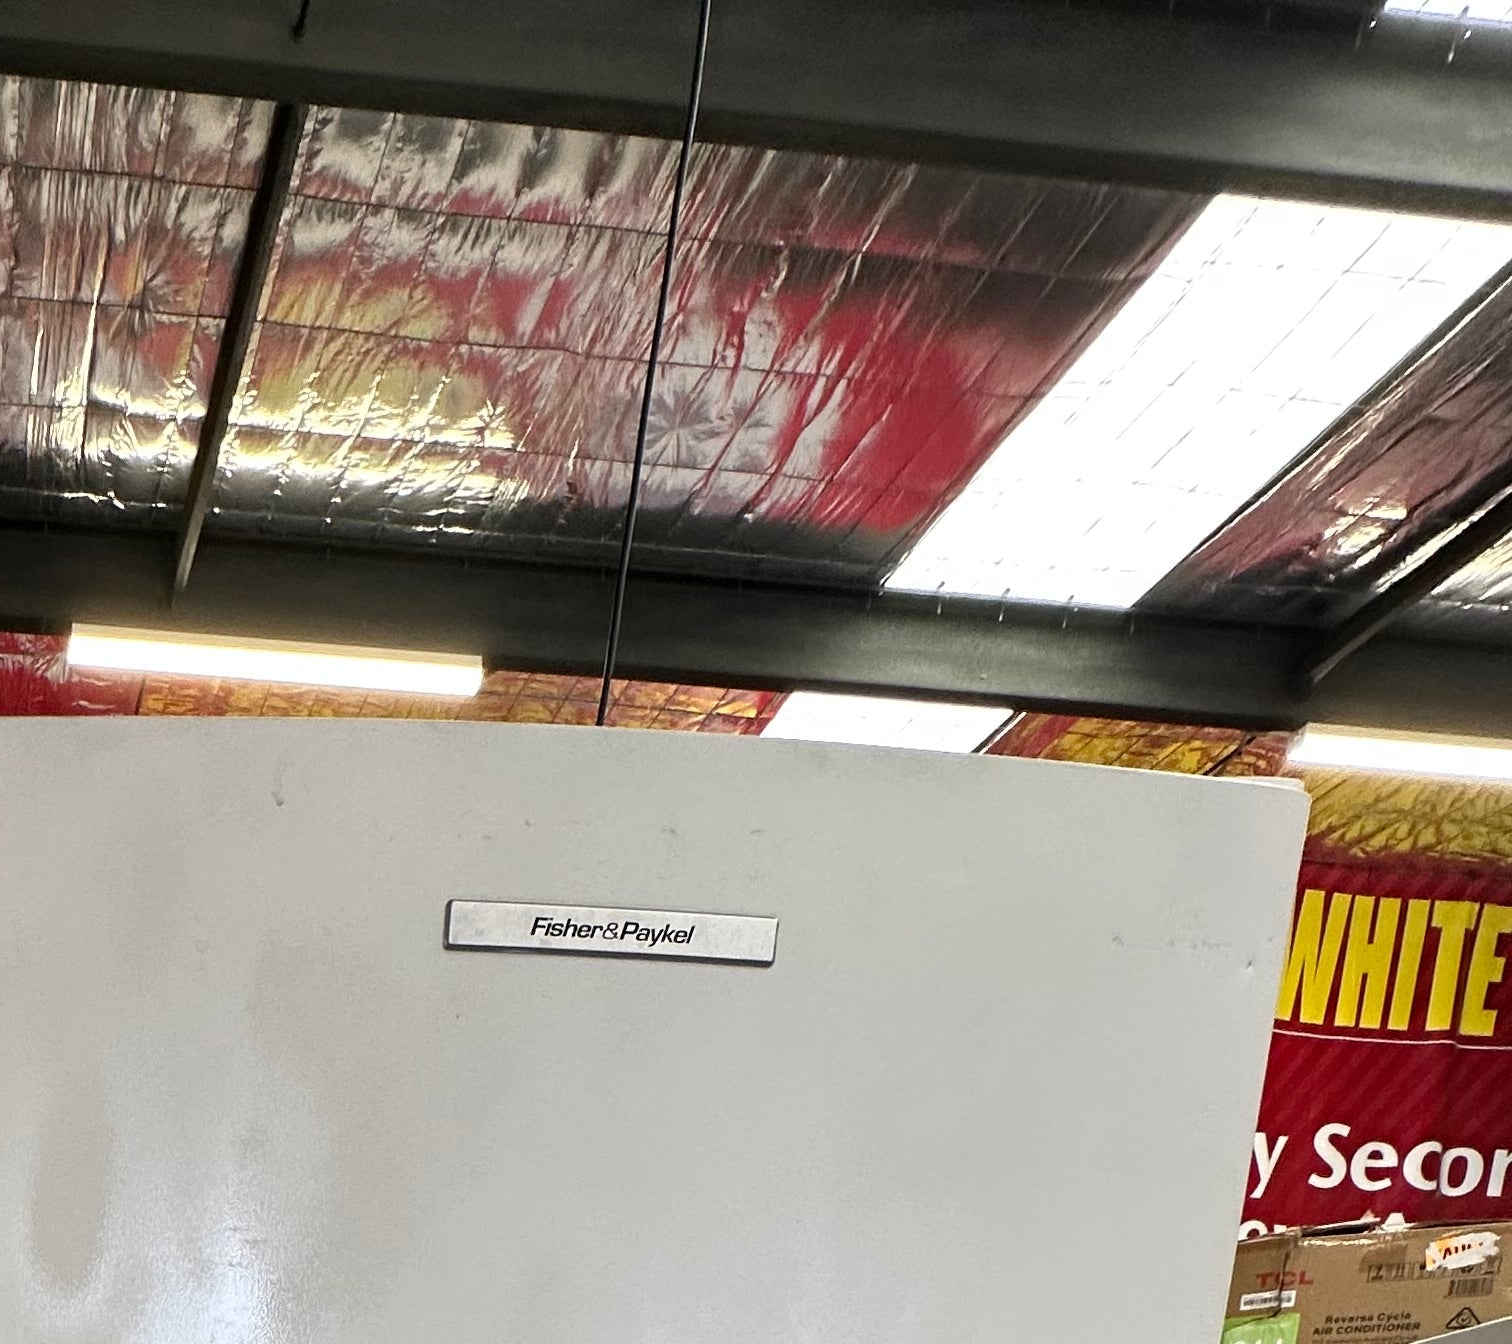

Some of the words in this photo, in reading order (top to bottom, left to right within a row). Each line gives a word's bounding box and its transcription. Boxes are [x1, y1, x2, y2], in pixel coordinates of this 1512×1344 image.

[530, 916, 695, 948] Fisher&Paykel
[1275, 889, 1512, 1036] WHITE
[1256, 1269, 1314, 1288] TCL
[1312, 1326, 1333, 1336] AIR
[1336, 1322, 1421, 1335] CONDITIONER
